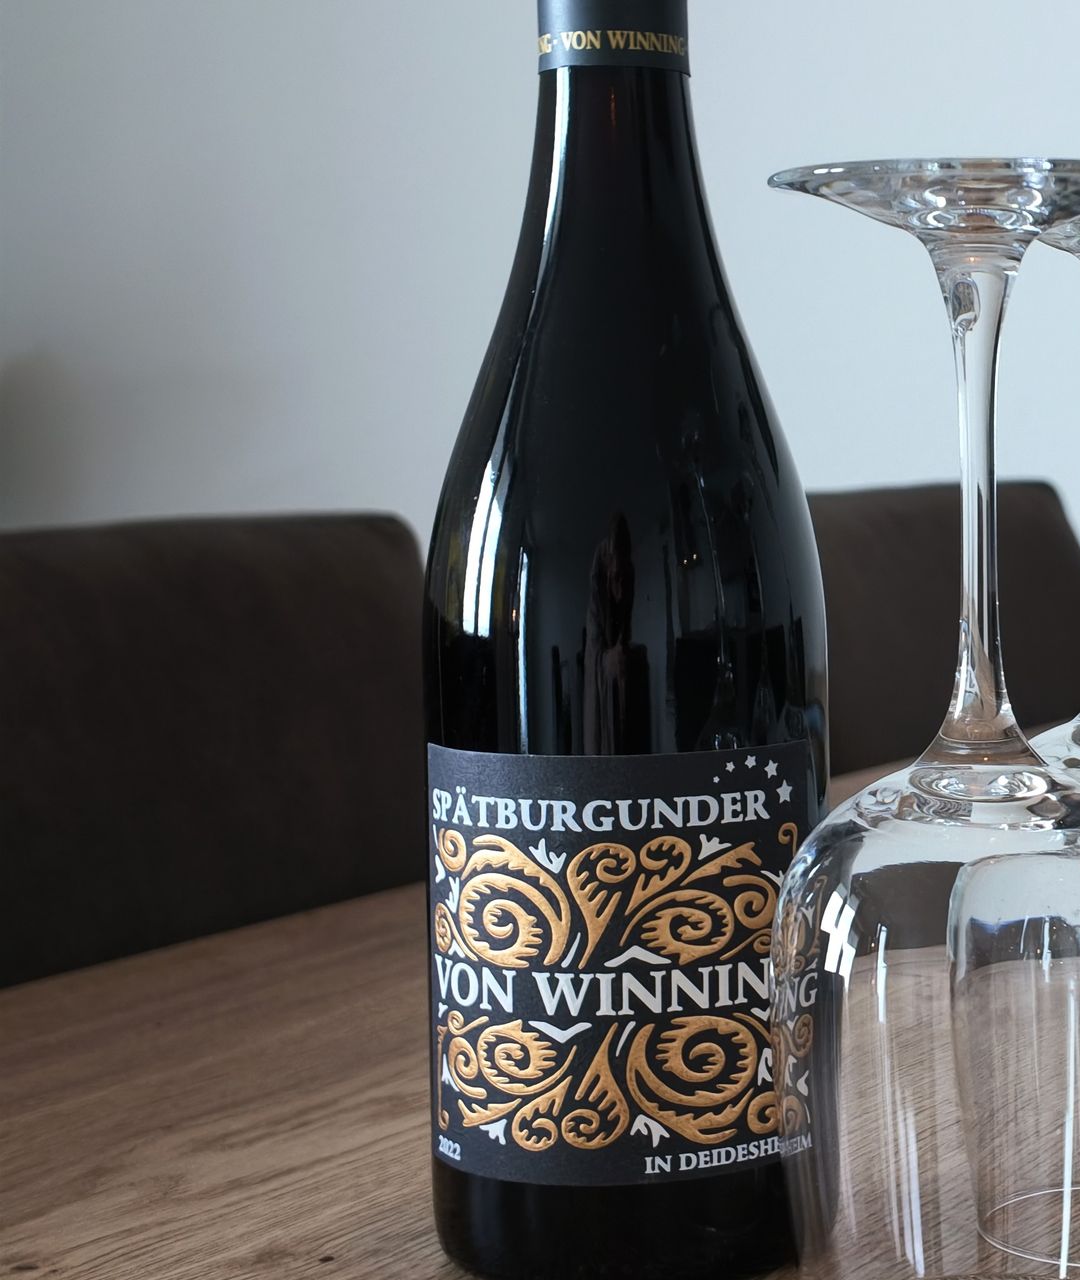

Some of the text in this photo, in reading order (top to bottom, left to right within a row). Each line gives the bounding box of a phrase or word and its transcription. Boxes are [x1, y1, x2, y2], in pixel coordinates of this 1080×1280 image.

[560, 30, 602, 51] VON
[606, 30, 684, 55] WINNING
[432, 785, 770, 832] SPÄTBURGUNDER
[435, 953, 517, 1013] VON
[644, 1155, 672, 1174] IN
